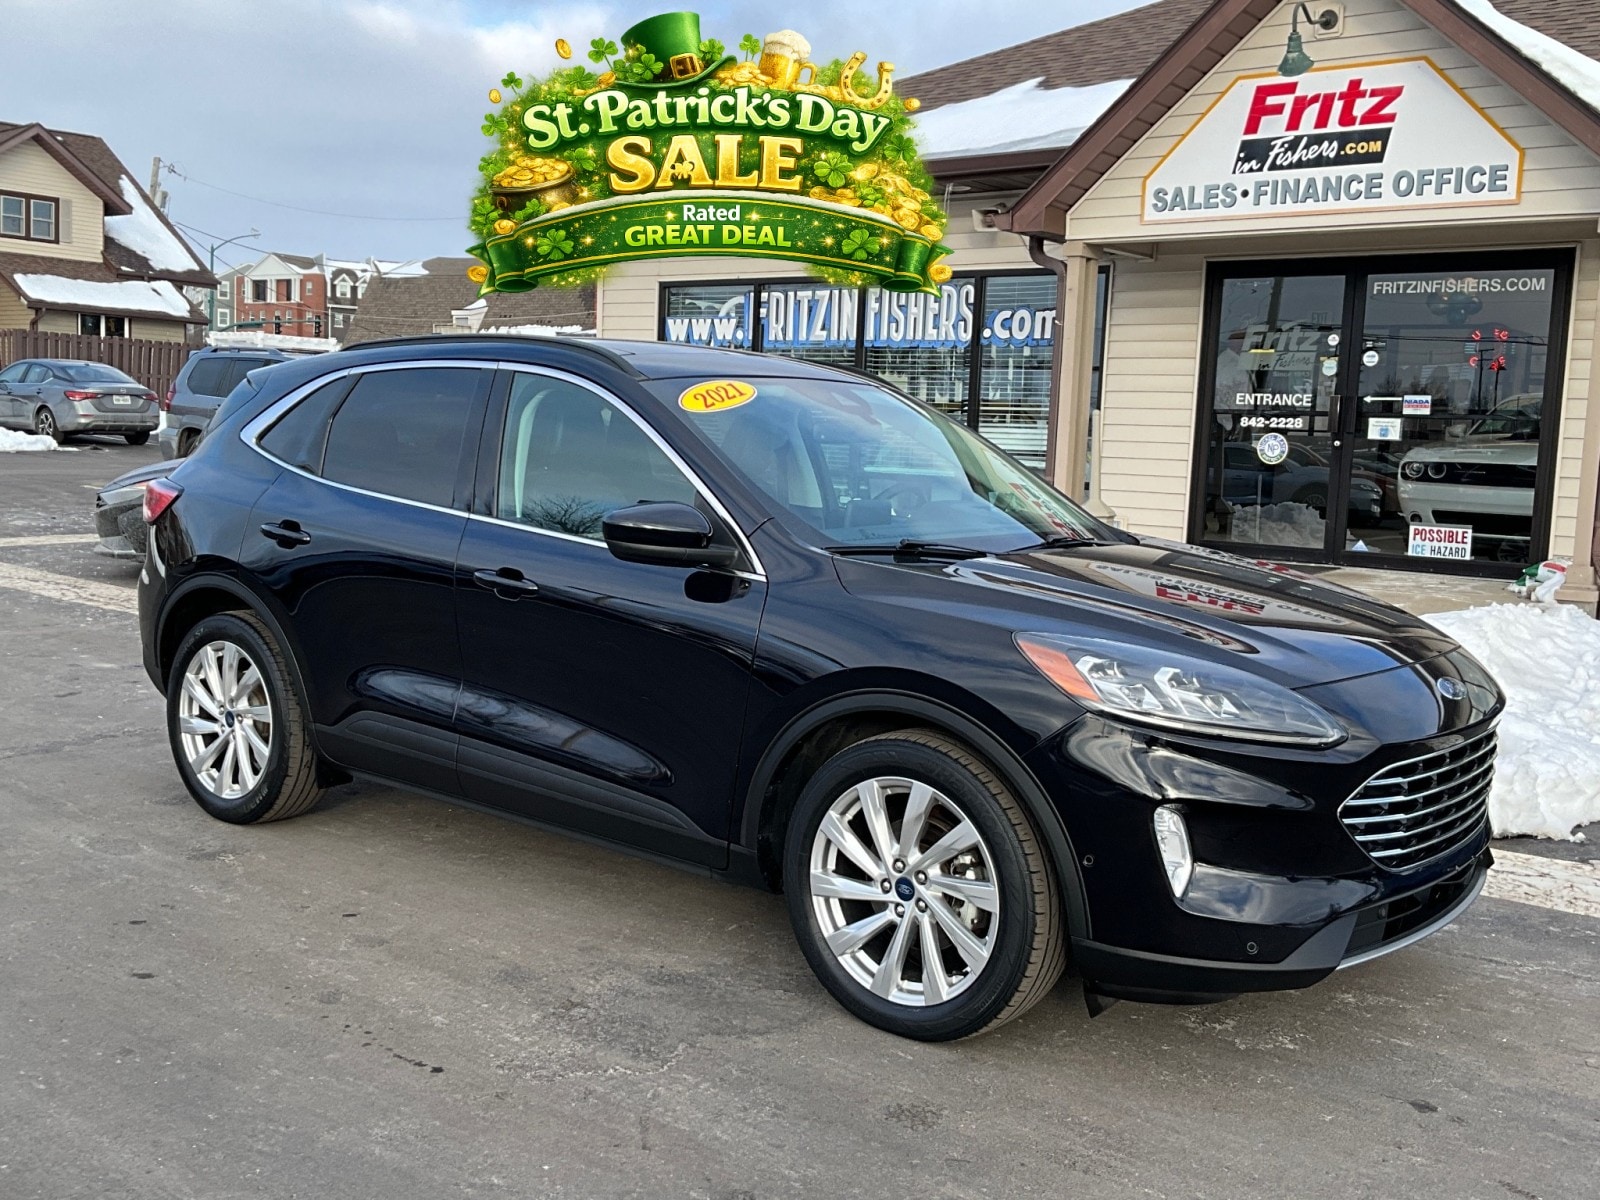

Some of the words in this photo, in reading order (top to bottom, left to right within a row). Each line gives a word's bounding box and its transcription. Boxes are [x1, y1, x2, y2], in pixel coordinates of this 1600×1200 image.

[1243, 78, 1405, 136] Fritz
[1235, 152, 1262, 174] in
[1392, 163, 1510, 197] OFFICE
[1372, 277, 1546, 295] FRITZINFISHERS.COM
[693, 383, 748, 409] 2021
[1235, 393, 1313, 407] ENTRANCE
[1240, 416, 1303, 428] 842-2228
[1412, 527, 1469, 545] POSSIBLE
[1411, 543, 1427, 555] ICE
[1429, 545, 1467, 558] HAZARD
